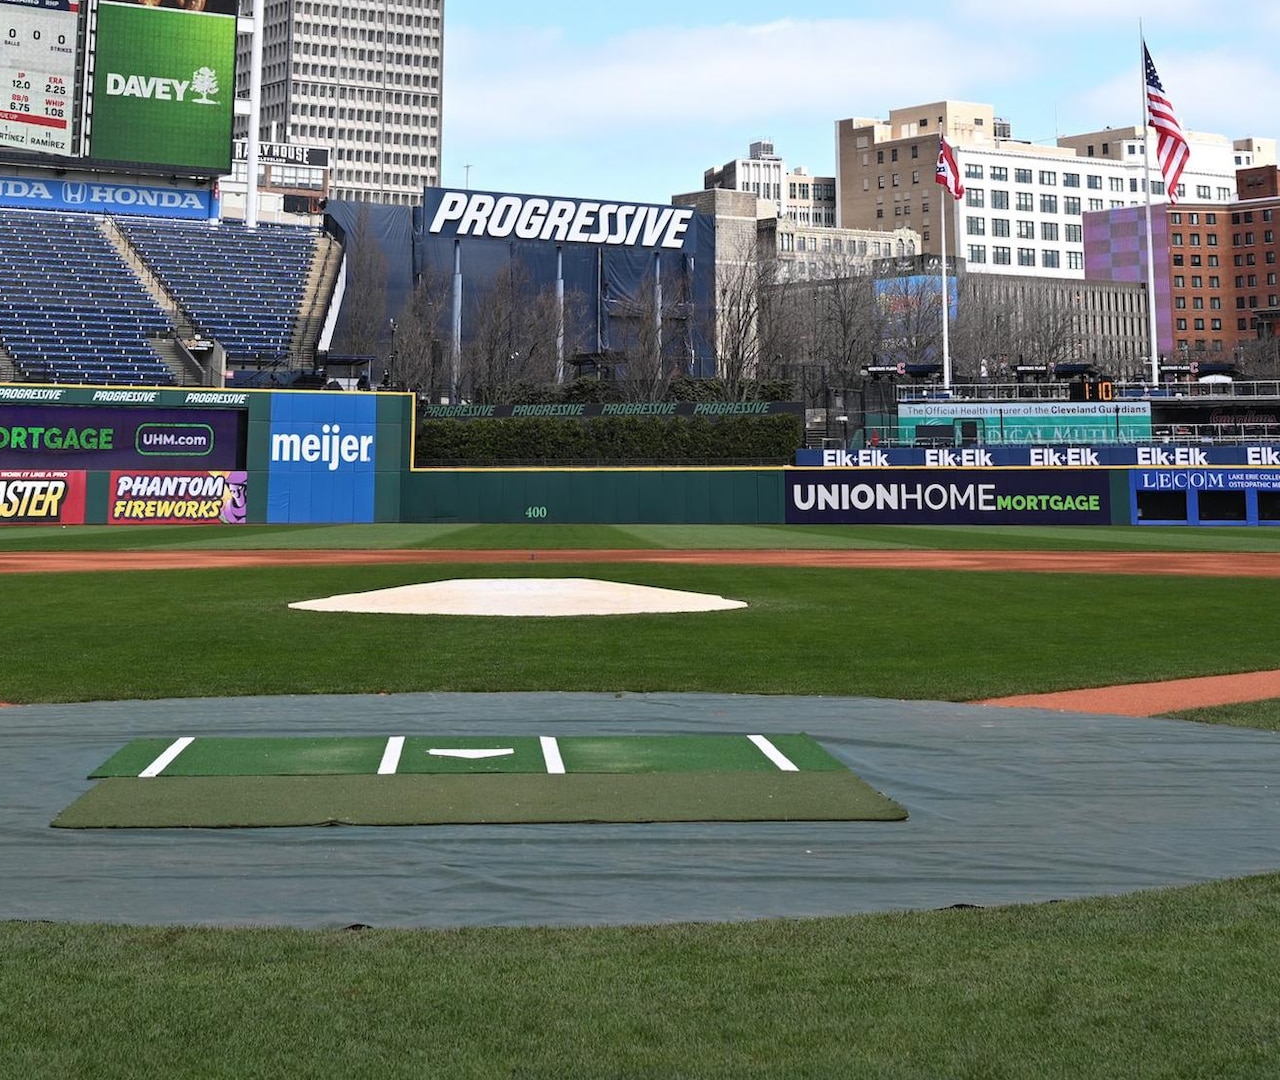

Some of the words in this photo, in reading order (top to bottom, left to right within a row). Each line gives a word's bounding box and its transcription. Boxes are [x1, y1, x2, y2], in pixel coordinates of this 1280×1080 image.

[106, 73, 190, 101] DAVEY
[235, 143, 269, 159] RALY
[272, 146, 309, 164] HOUSE
[91, 186, 205, 209] HONDA
[429, 191, 694, 249] PROGRESSIVE
[93, 391, 157, 404] PROGRESSIVE
[185, 392, 248, 405] PROGRESSIVE
[1085, 382, 1112, 400] 1:10
[424, 405, 495, 417] PROGRESSIVE
[512, 403, 585, 416] PROGRESSIVE
[601, 402, 676, 415] PROGRESSIVE
[693, 401, 770, 414] PROGRESSIVE
[908, 406, 925, 414] The
[926, 406, 957, 415] Official
[961, 406, 988, 414] Health
[990, 406, 1021, 414] Insurer
[1023, 406, 1034, 414] of
[1035, 406, 1048, 414] the
[1051, 405, 1096, 414] Cleveland
[1098, 405, 1146, 414] Guardians
[143, 433, 207, 448] UHM.com
[271, 425, 370, 470] meijer
[118, 476, 224, 498] PHANTOM
[113, 500, 221, 519] FIREWORKS
[525, 506, 547, 519] 400
